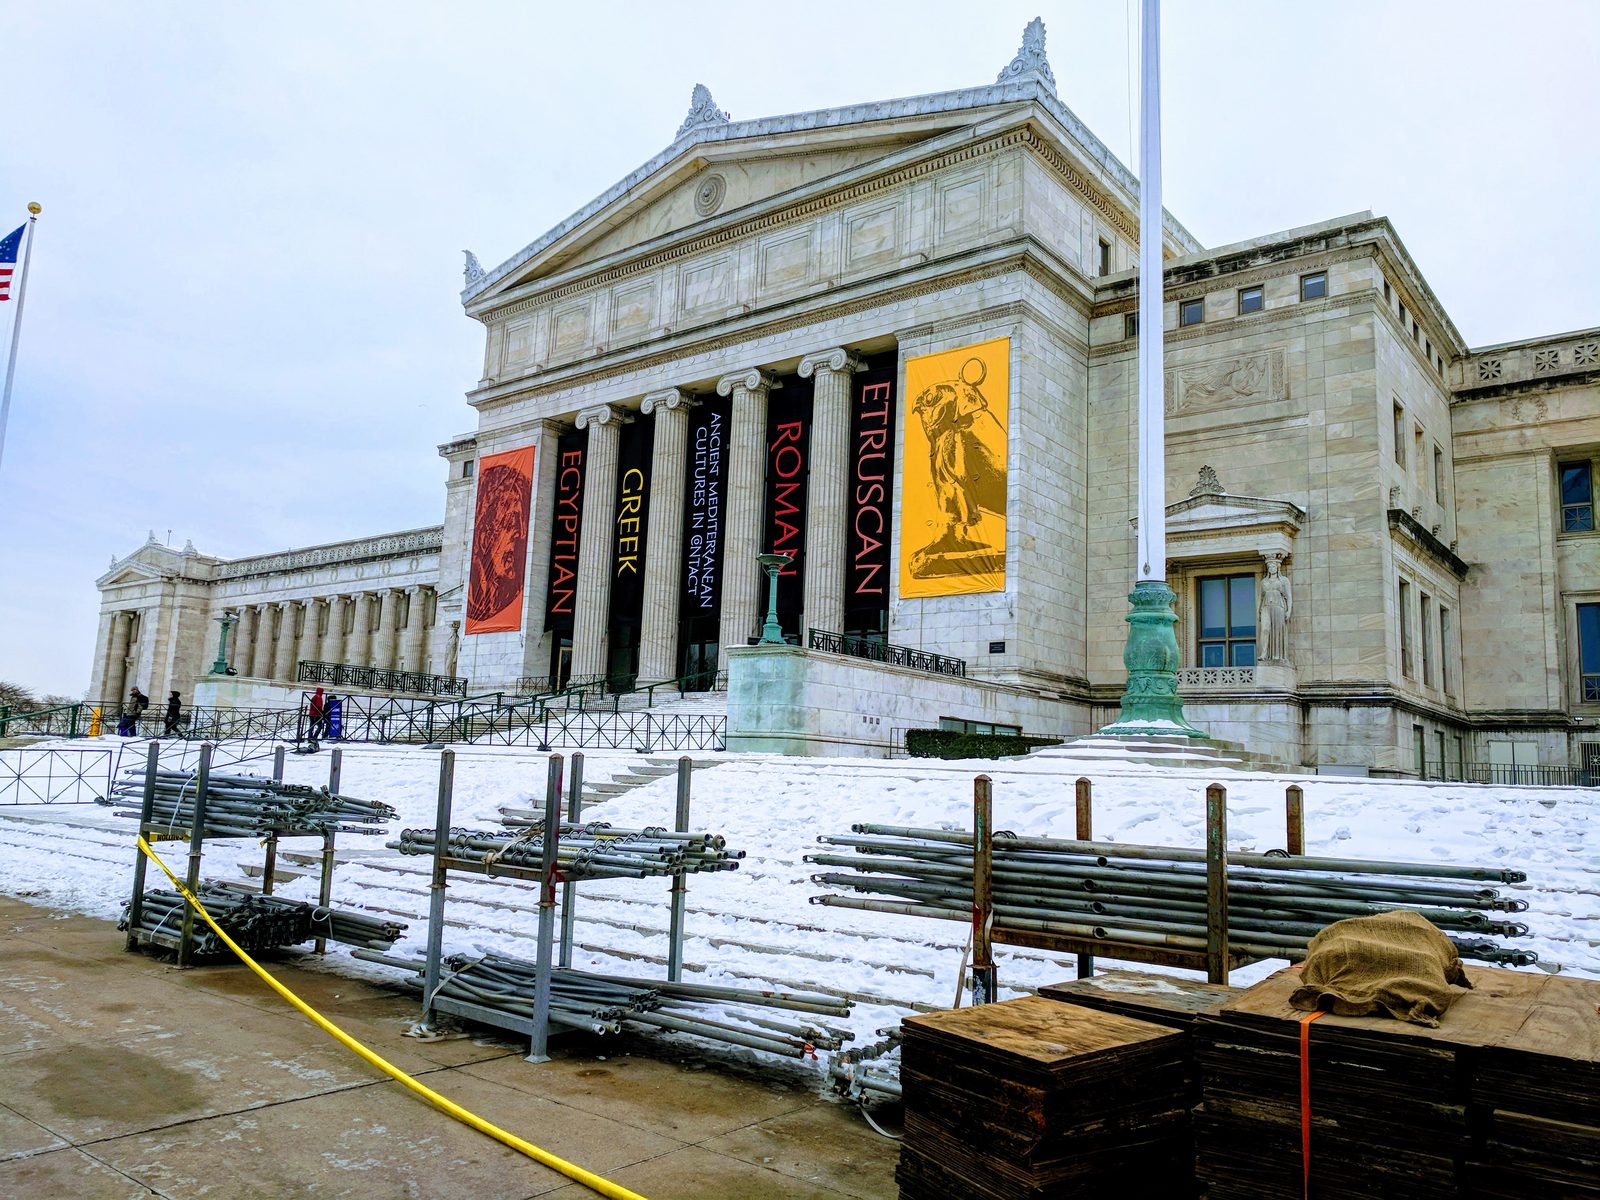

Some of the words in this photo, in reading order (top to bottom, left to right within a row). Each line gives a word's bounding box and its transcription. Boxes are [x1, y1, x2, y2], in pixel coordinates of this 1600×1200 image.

[693, 427, 708, 507] CULTURES
[709, 412, 722, 476] ANCIENT
[770, 421, 802, 576] ROMAN
[855, 381, 891, 594] ETRUSCAN
[552, 450, 582, 614] EGYPTIAN
[617, 468, 644, 578] GREEK
[692, 513, 704, 529] IN
[700, 481, 719, 608] MEDITERRANEAN
